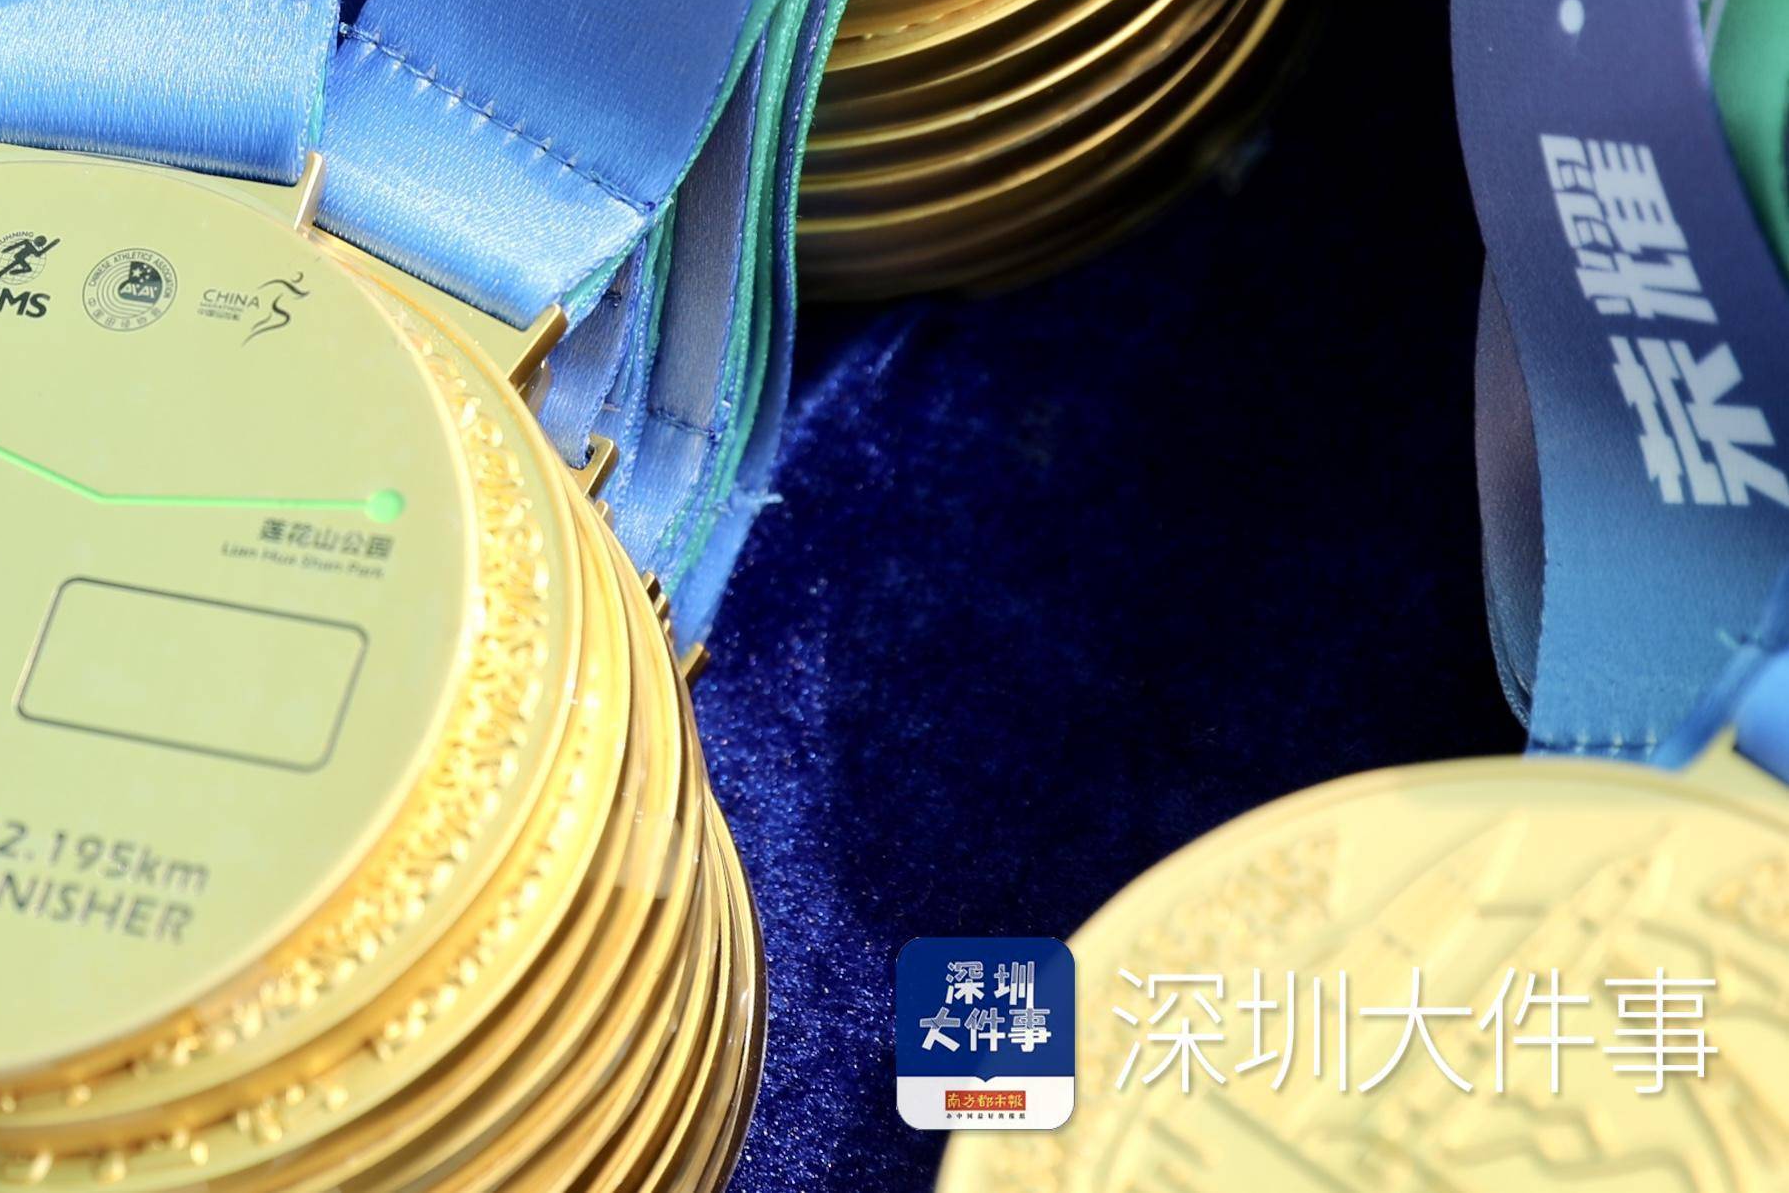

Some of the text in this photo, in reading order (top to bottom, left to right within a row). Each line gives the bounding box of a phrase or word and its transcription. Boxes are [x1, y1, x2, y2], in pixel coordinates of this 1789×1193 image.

[113, 251, 154, 264] ATHLETICS
[203, 288, 260, 309] CHINA
[1539, 134, 1789, 507] 荣耀
[260, 518, 394, 560] 莲花山公园
